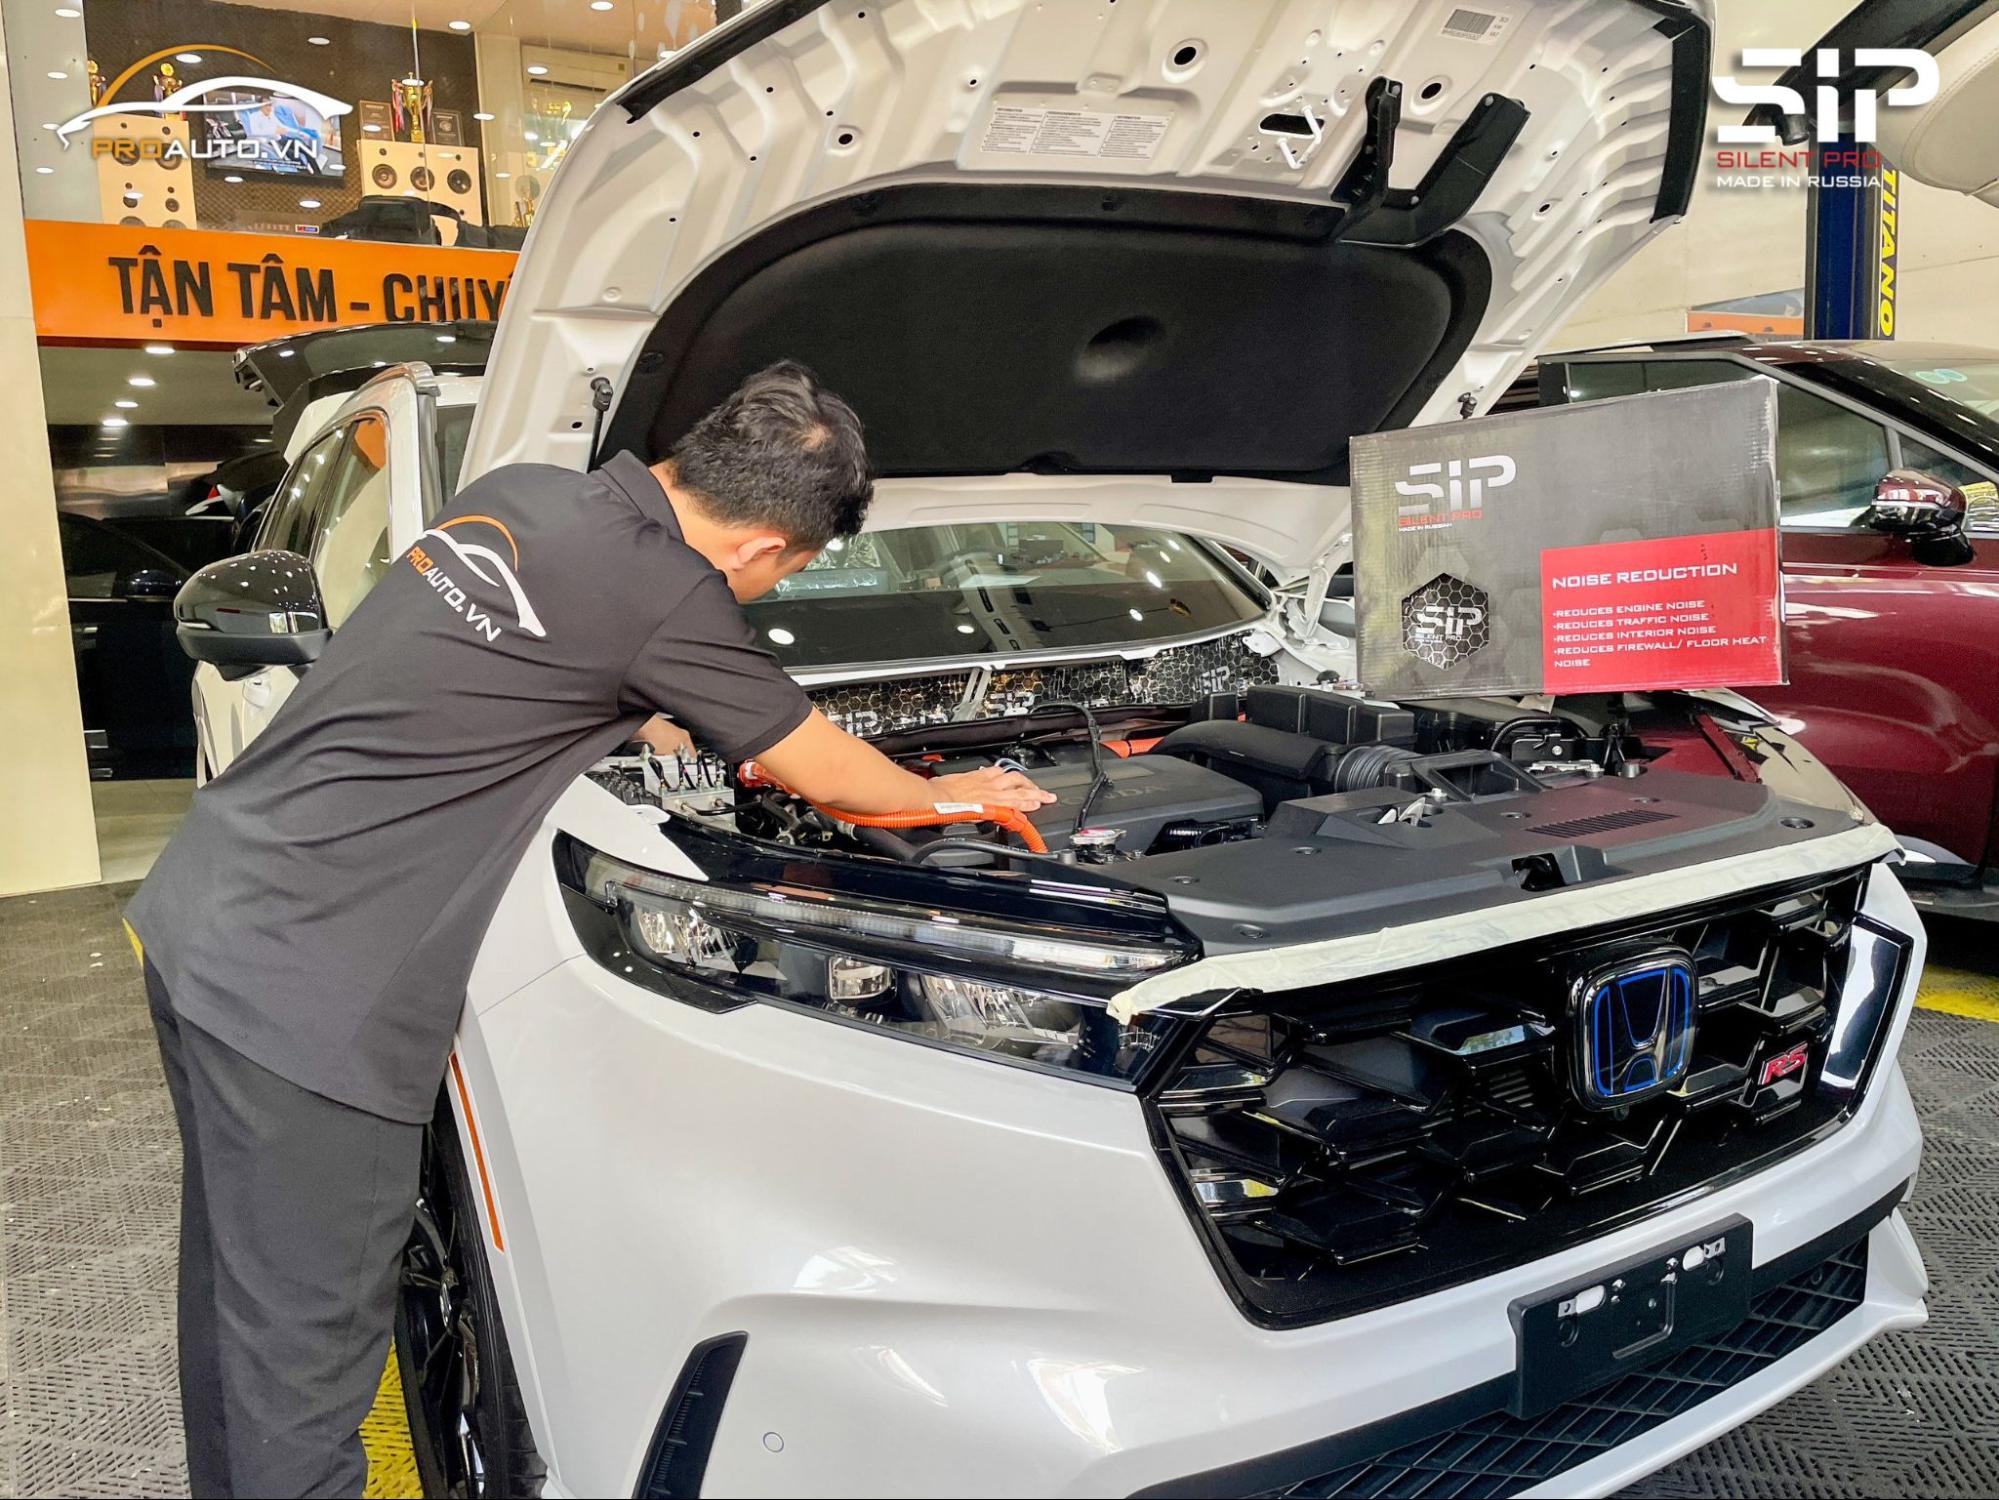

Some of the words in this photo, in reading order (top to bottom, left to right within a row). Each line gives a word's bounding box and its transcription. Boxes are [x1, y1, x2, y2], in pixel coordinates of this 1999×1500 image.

[1880, 168, 1897, 337] TITANO
[108, 245, 213, 328] TẬN
[227, 253, 338, 322] TÂM
[383, 272, 513, 323] CHUY
[1552, 573, 1612, 590] NOISE
[1616, 563, 1738, 585] REDUCTION
[406, 546, 502, 642] PROAUTO.VN
[1616, 603, 1664, 613] ENGINE
[1666, 600, 1706, 610] NOISE
[1616, 616, 1667, 626] TRAFFIC
[1670, 613, 1710, 623] NOISE
[1616, 628, 1674, 639] INTERIOR
[1677, 625, 1717, 636] NOISE
[1686, 638, 1729, 648] FLOOR
[1732, 636, 1768, 645] HEAT
[1554, 659, 1591, 668] NOISE
[1762, 1043, 1808, 1085] RS
